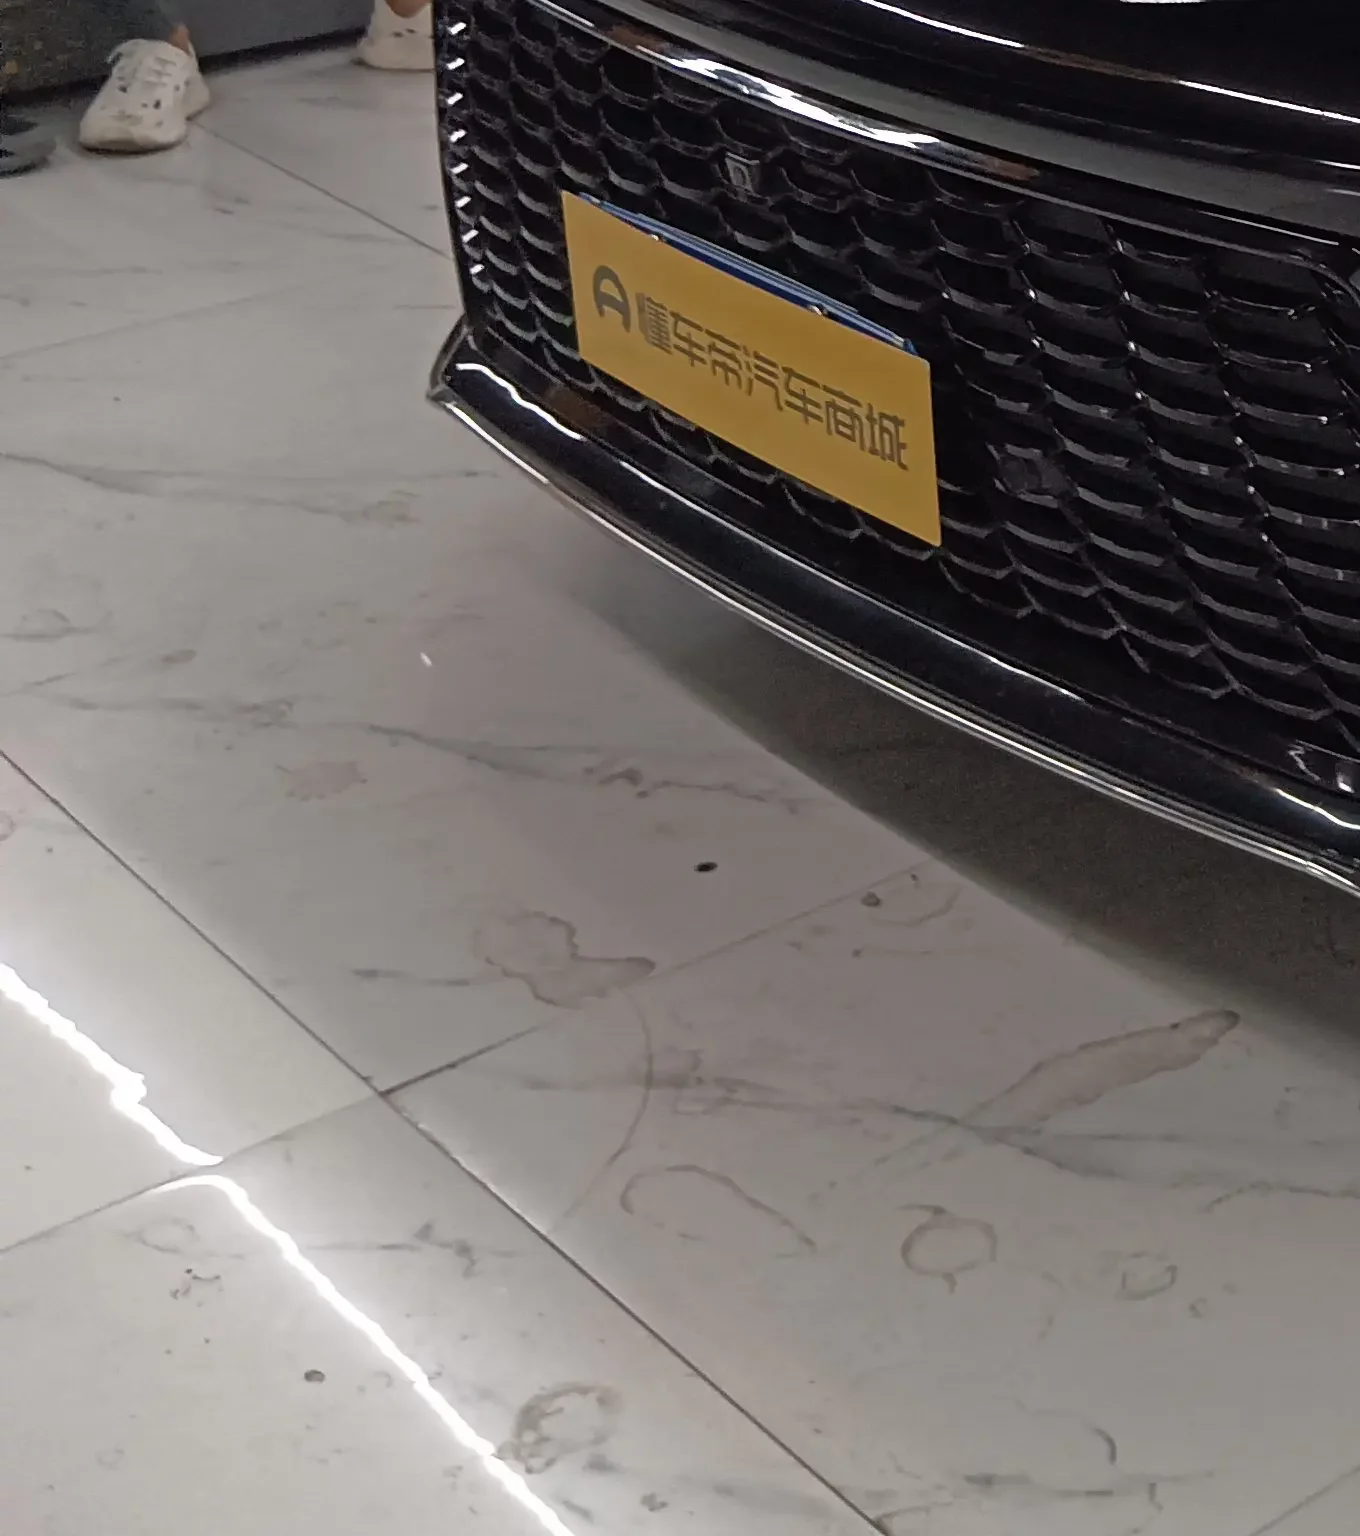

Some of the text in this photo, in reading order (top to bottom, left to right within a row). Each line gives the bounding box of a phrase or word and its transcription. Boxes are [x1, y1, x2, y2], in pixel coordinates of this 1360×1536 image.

[637, 290, 910, 471] 懂车帝汽车商城
